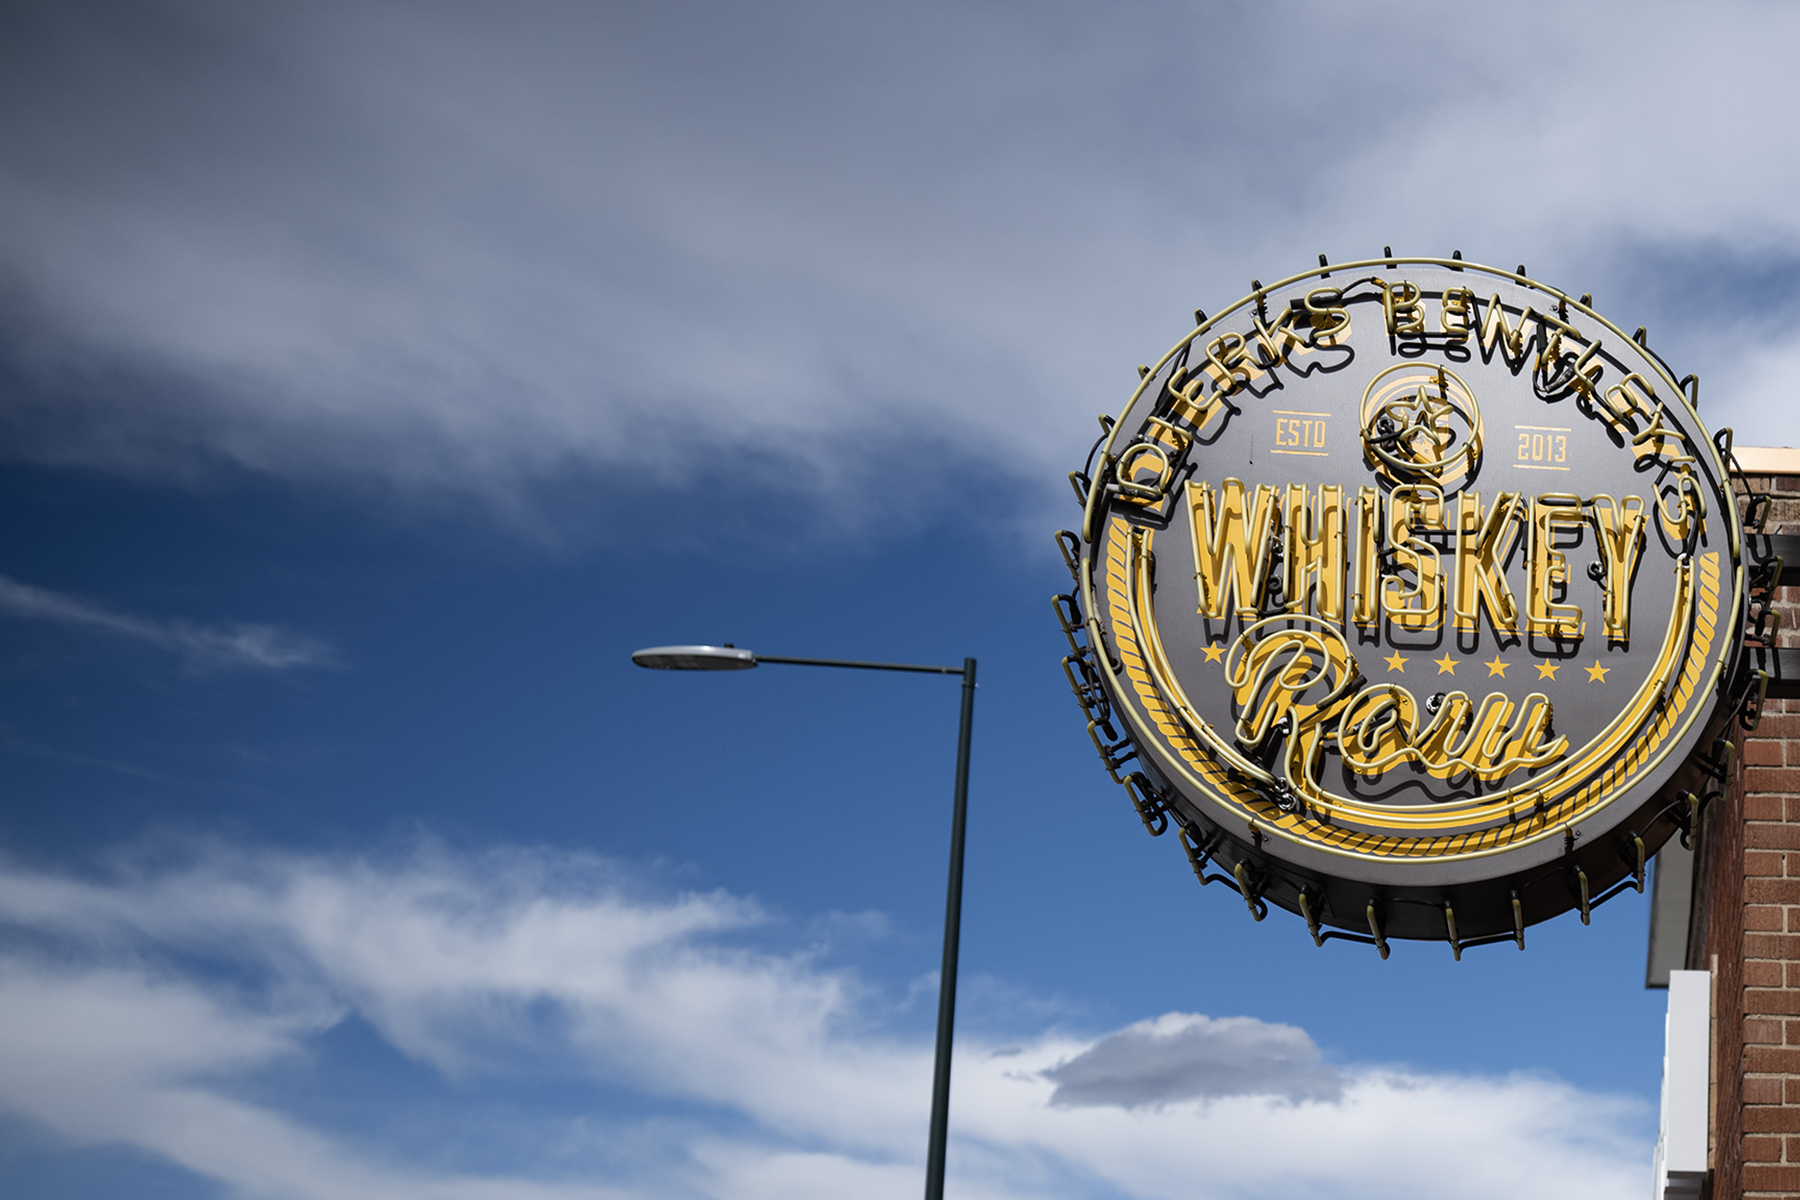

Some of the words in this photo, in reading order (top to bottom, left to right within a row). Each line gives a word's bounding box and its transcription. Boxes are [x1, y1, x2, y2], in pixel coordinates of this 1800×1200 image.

[1110, 286, 1352, 512] DIERKS
[1275, 417, 1327, 449] ESTD
[1517, 432, 1568, 463] 2013
[1185, 478, 1650, 643] WHISKEY
[1225, 615, 1570, 787] Row
